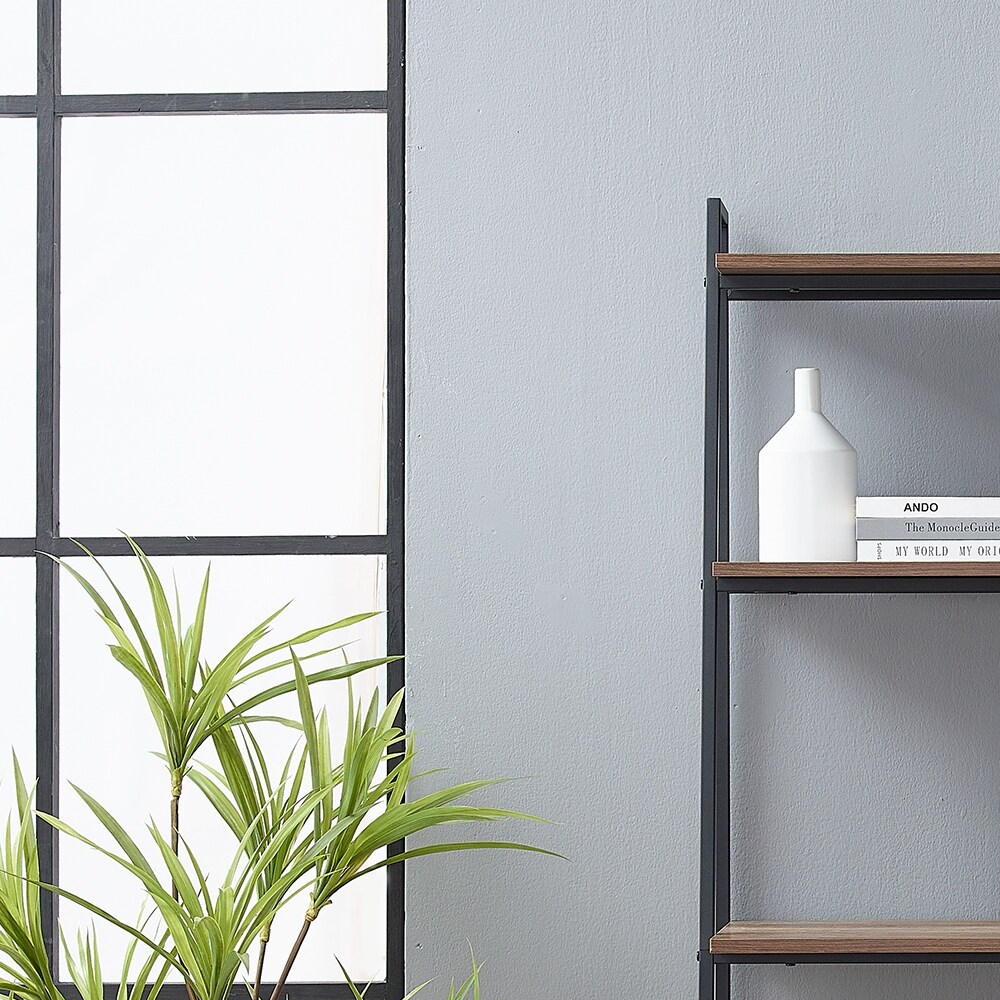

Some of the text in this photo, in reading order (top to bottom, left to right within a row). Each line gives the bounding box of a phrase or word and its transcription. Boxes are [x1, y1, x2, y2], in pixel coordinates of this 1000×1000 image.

[903, 502, 939, 513] ANDO
[904, 522, 925, 533] The
[895, 545, 909, 557] MY
[913, 545, 949, 557] WORLD
[958, 545, 973, 557] MY
